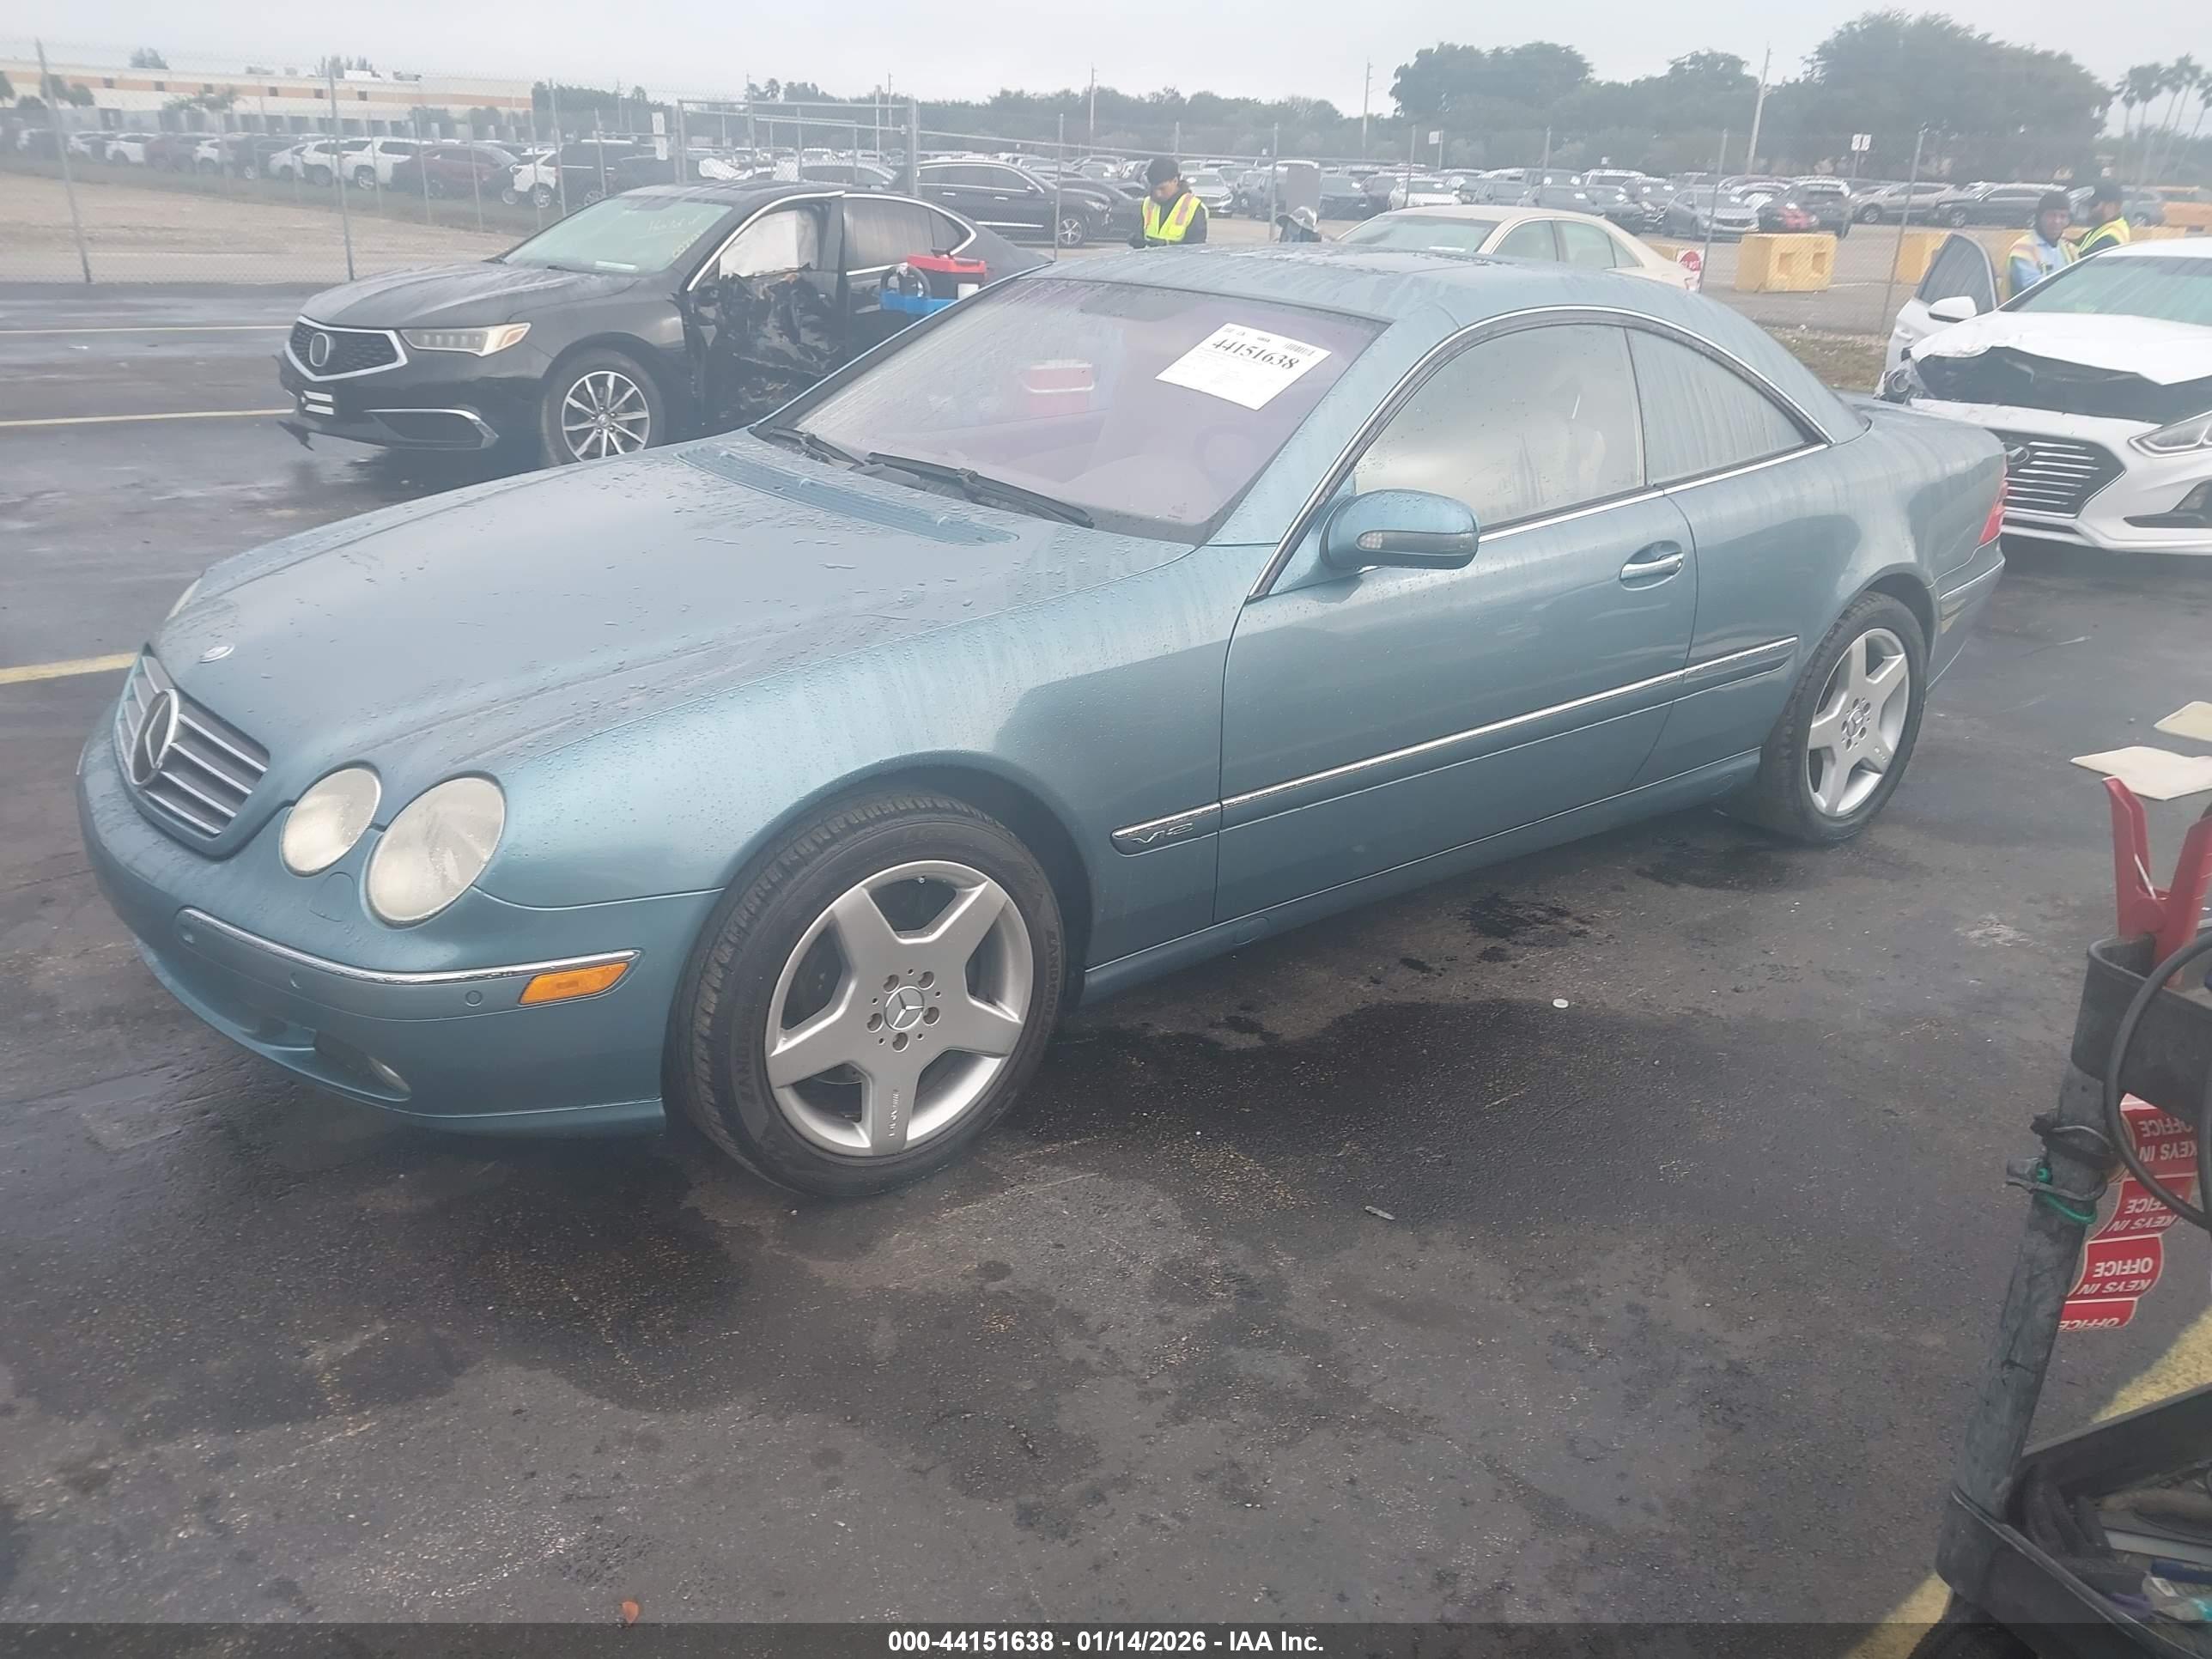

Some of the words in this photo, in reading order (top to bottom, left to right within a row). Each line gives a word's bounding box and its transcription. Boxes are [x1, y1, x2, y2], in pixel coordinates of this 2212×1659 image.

[1212, 338, 1300, 369] 44151638
[2139, 1146, 2156, 1162] IN
[2160, 1140, 2197, 1161] KEYS
[2106, 1219, 2131, 1232] IN
[2130, 1214, 2178, 1230] KEYS
[2093, 1257, 2154, 1278] OFFICE
[2077, 1283, 2102, 1295] IN
[2102, 1279, 2153, 1291] KEYS
[2059, 1317, 2120, 1330] OFFICE
